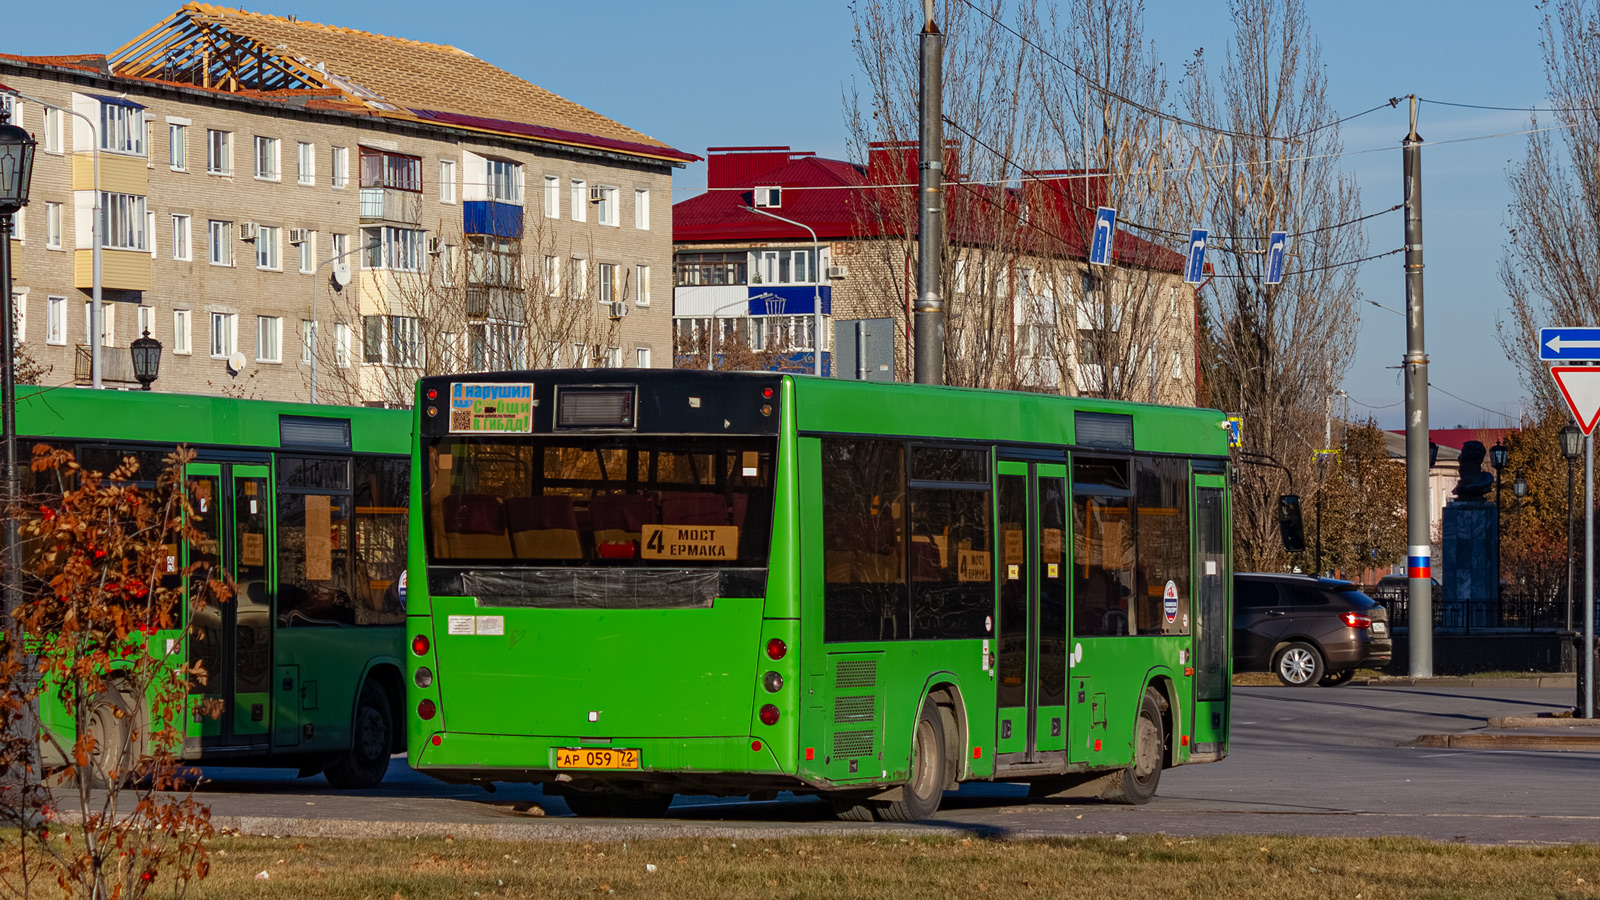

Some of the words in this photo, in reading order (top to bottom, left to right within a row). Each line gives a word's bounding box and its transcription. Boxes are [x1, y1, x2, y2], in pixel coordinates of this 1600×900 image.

[453, 383, 462, 398] Я
[465, 386, 530, 400] нарушил
[646, 530, 664, 554] 4
[678, 529, 715, 541] МОСТ
[670, 544, 726, 556] ЕРМАКА
[586, 752, 612, 766] 059
[620, 751, 633, 763] 72
